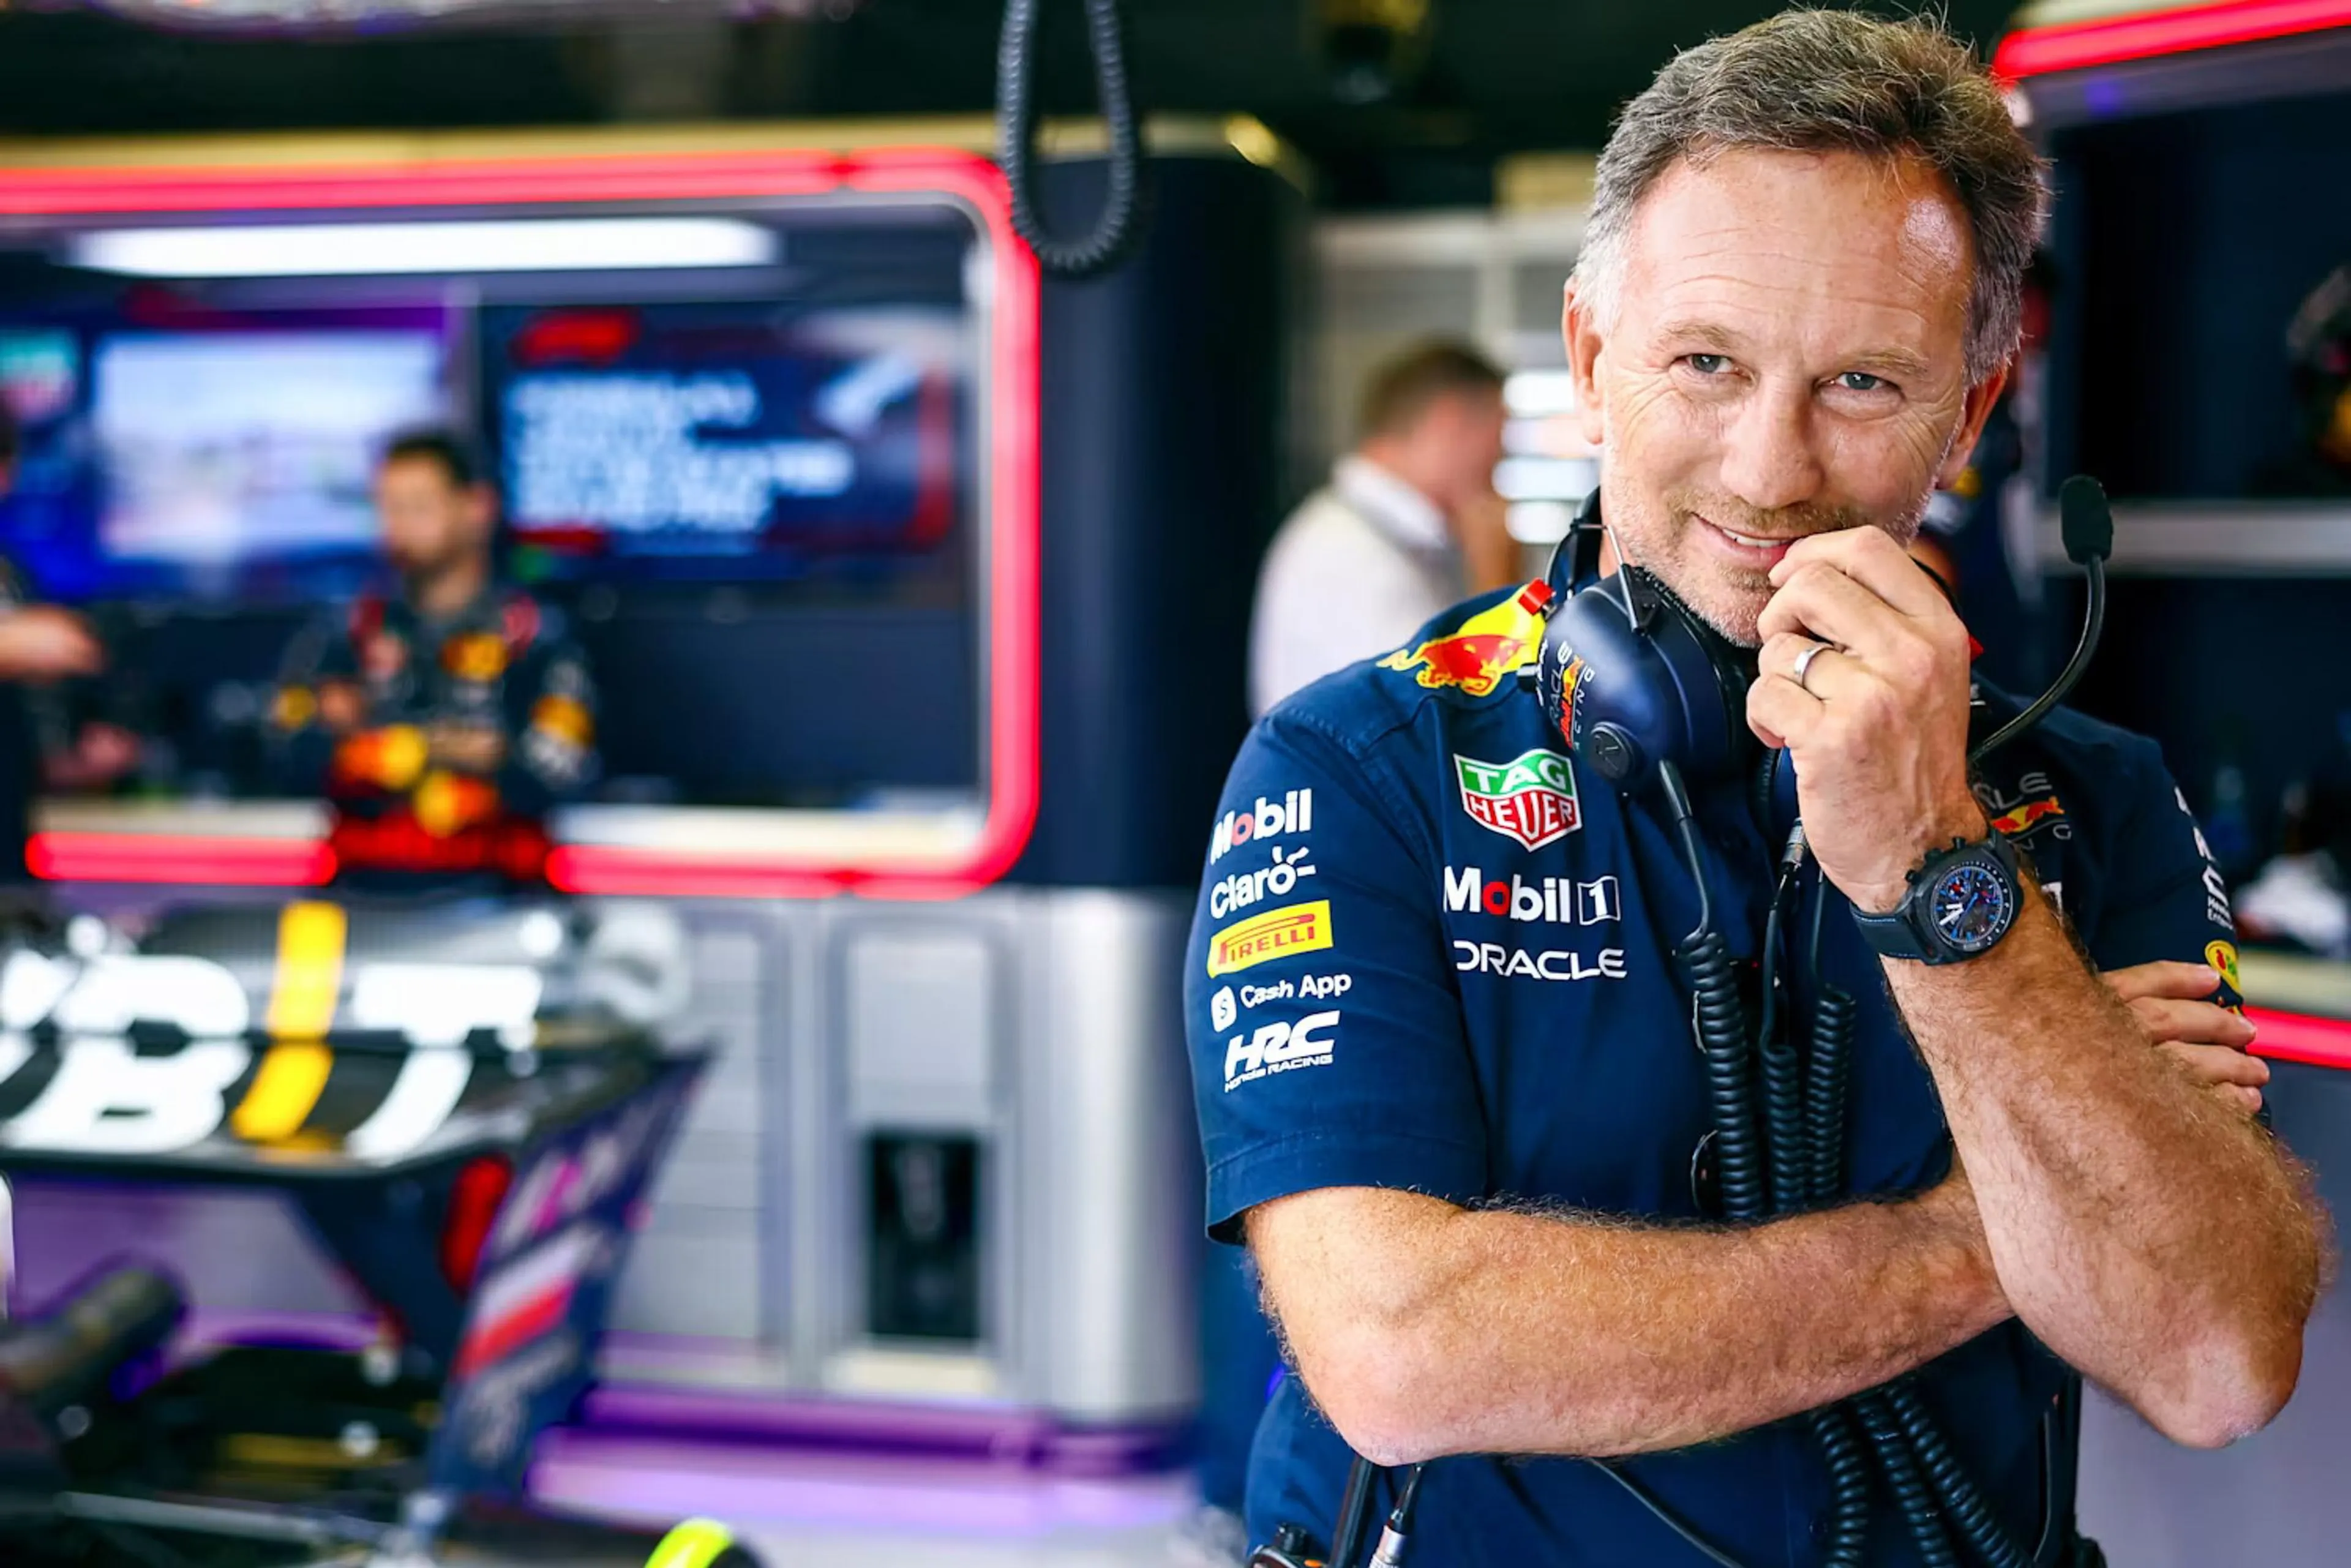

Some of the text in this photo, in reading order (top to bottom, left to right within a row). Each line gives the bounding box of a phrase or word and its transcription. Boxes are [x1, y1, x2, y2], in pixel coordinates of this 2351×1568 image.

[1465, 757, 1567, 792] TAG
[1210, 789, 1312, 865] Mobil
[1469, 792, 1574, 840] HEUER
[1211, 862, 1297, 919] Claro
[1443, 865, 1571, 924] Mobil
[1217, 914, 1316, 966] PIRELLI
[1453, 940, 1628, 980] ORACLE
[1240, 980, 1294, 1008] Cash
[1299, 974, 1352, 1000] App
[1224, 1010, 1340, 1082] HRC
[1268, 1054, 1333, 1075] RACING
